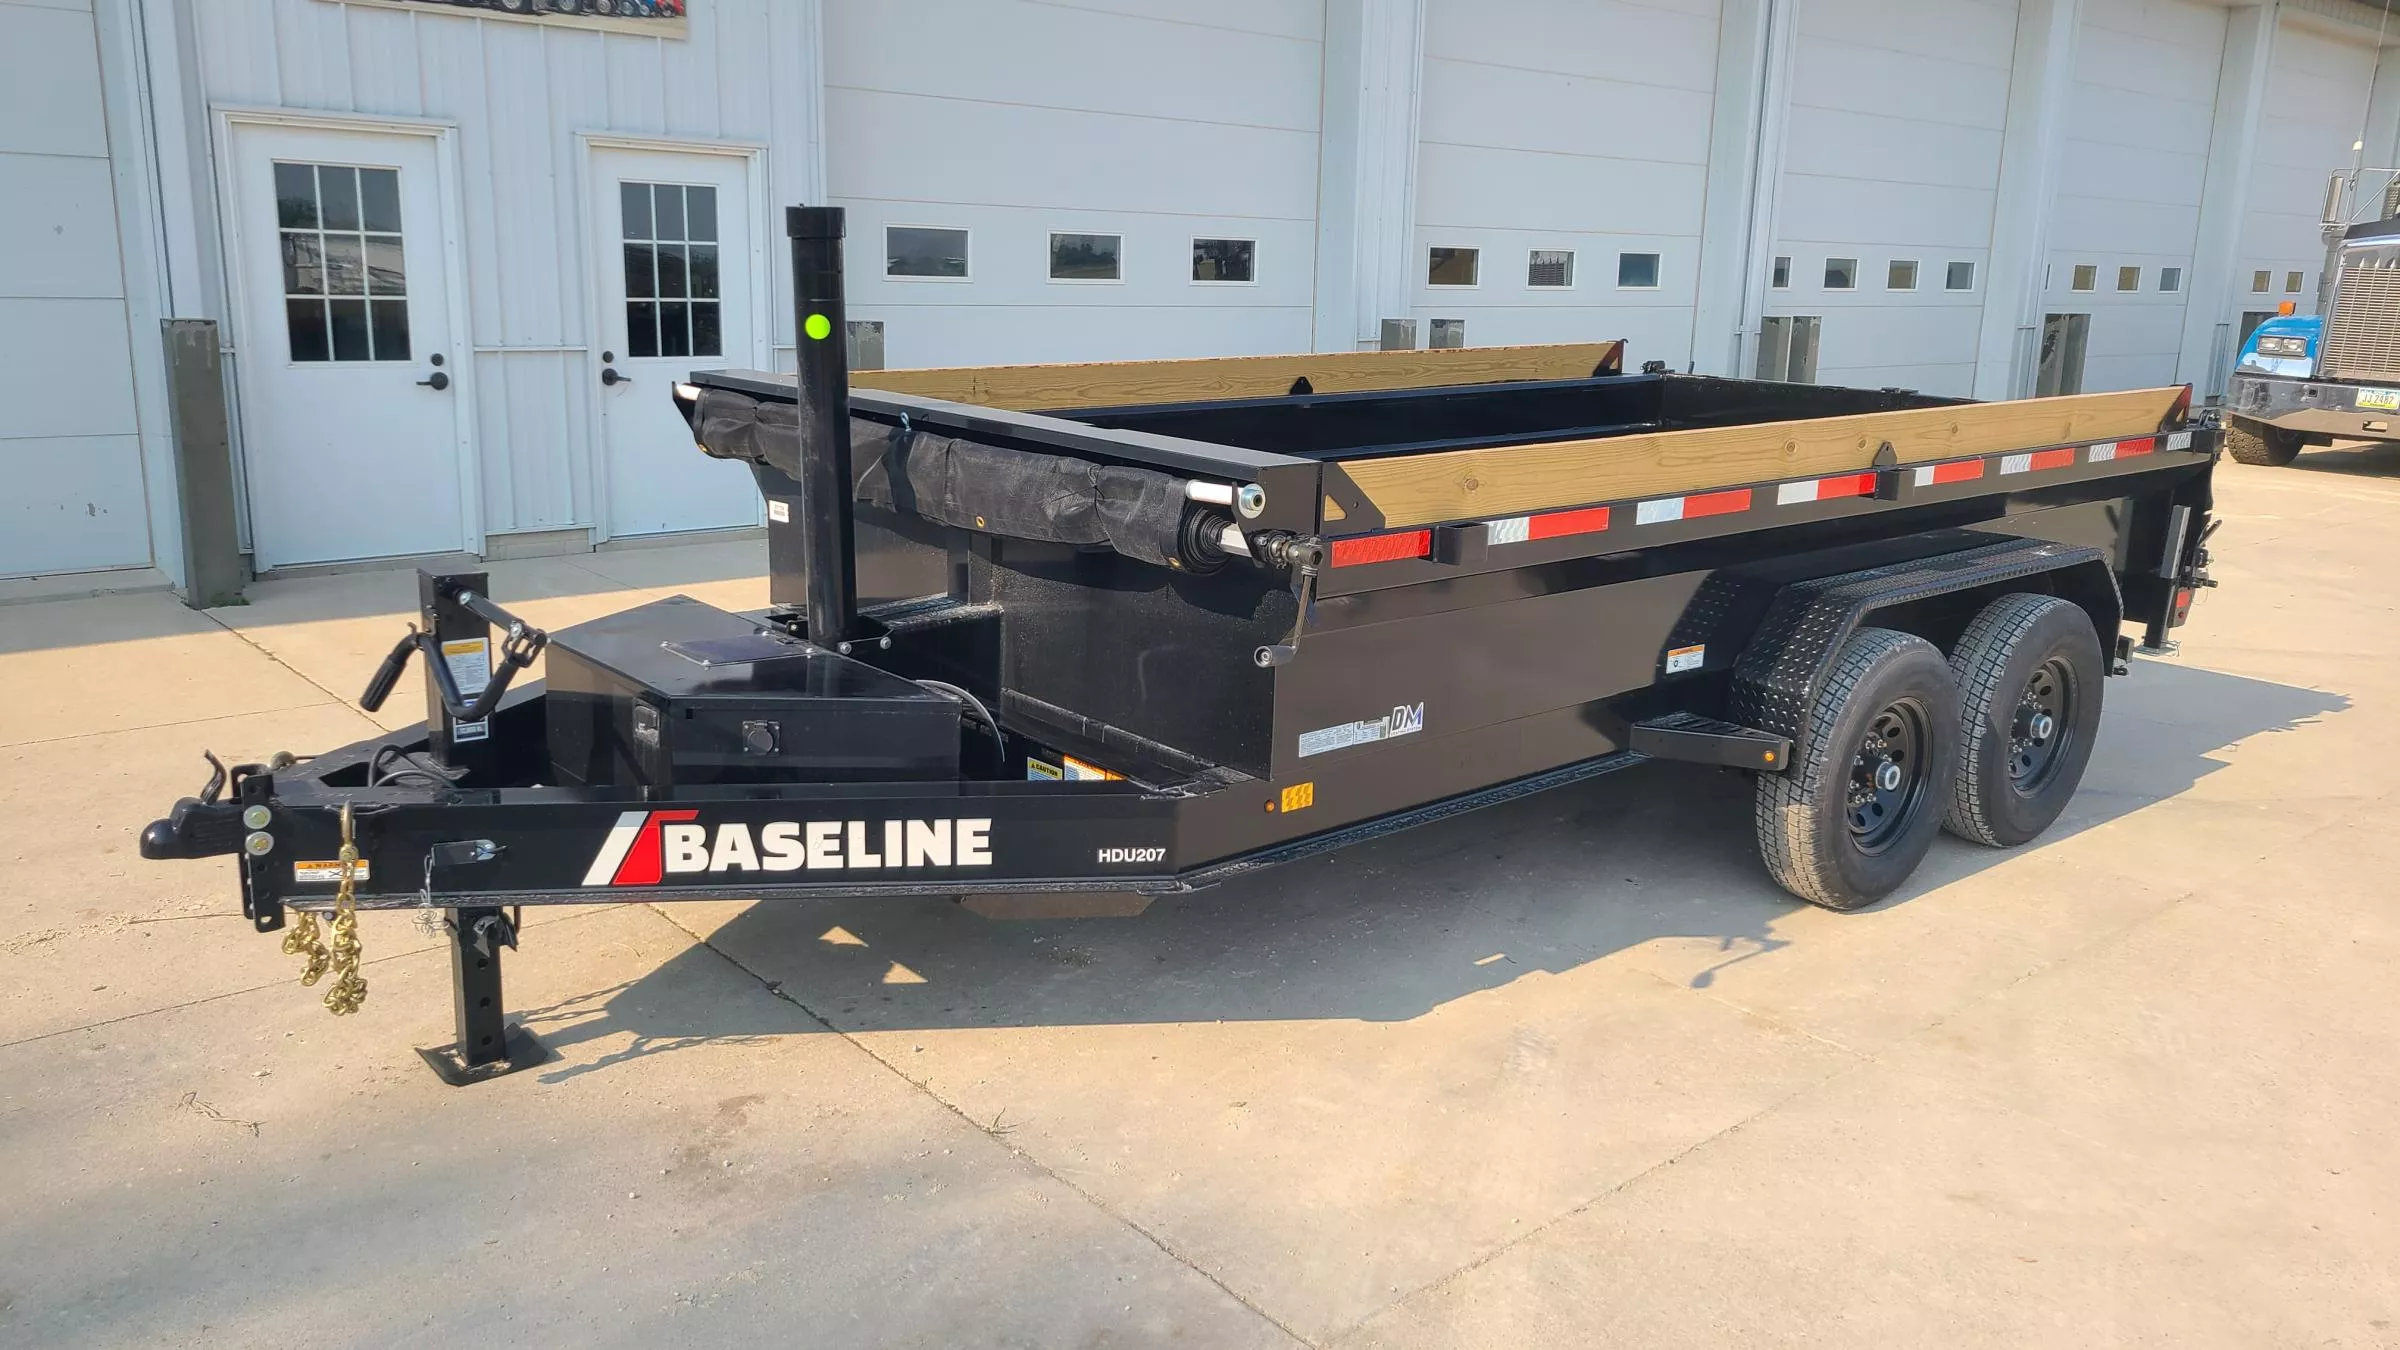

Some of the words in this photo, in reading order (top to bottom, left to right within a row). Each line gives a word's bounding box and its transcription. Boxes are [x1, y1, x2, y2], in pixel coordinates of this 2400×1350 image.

[1391, 702, 1423, 732] DM
[1036, 763, 1058, 777] CAUTION
[664, 818, 993, 873] BASELINE
[1098, 848, 1167, 863] HDU207
